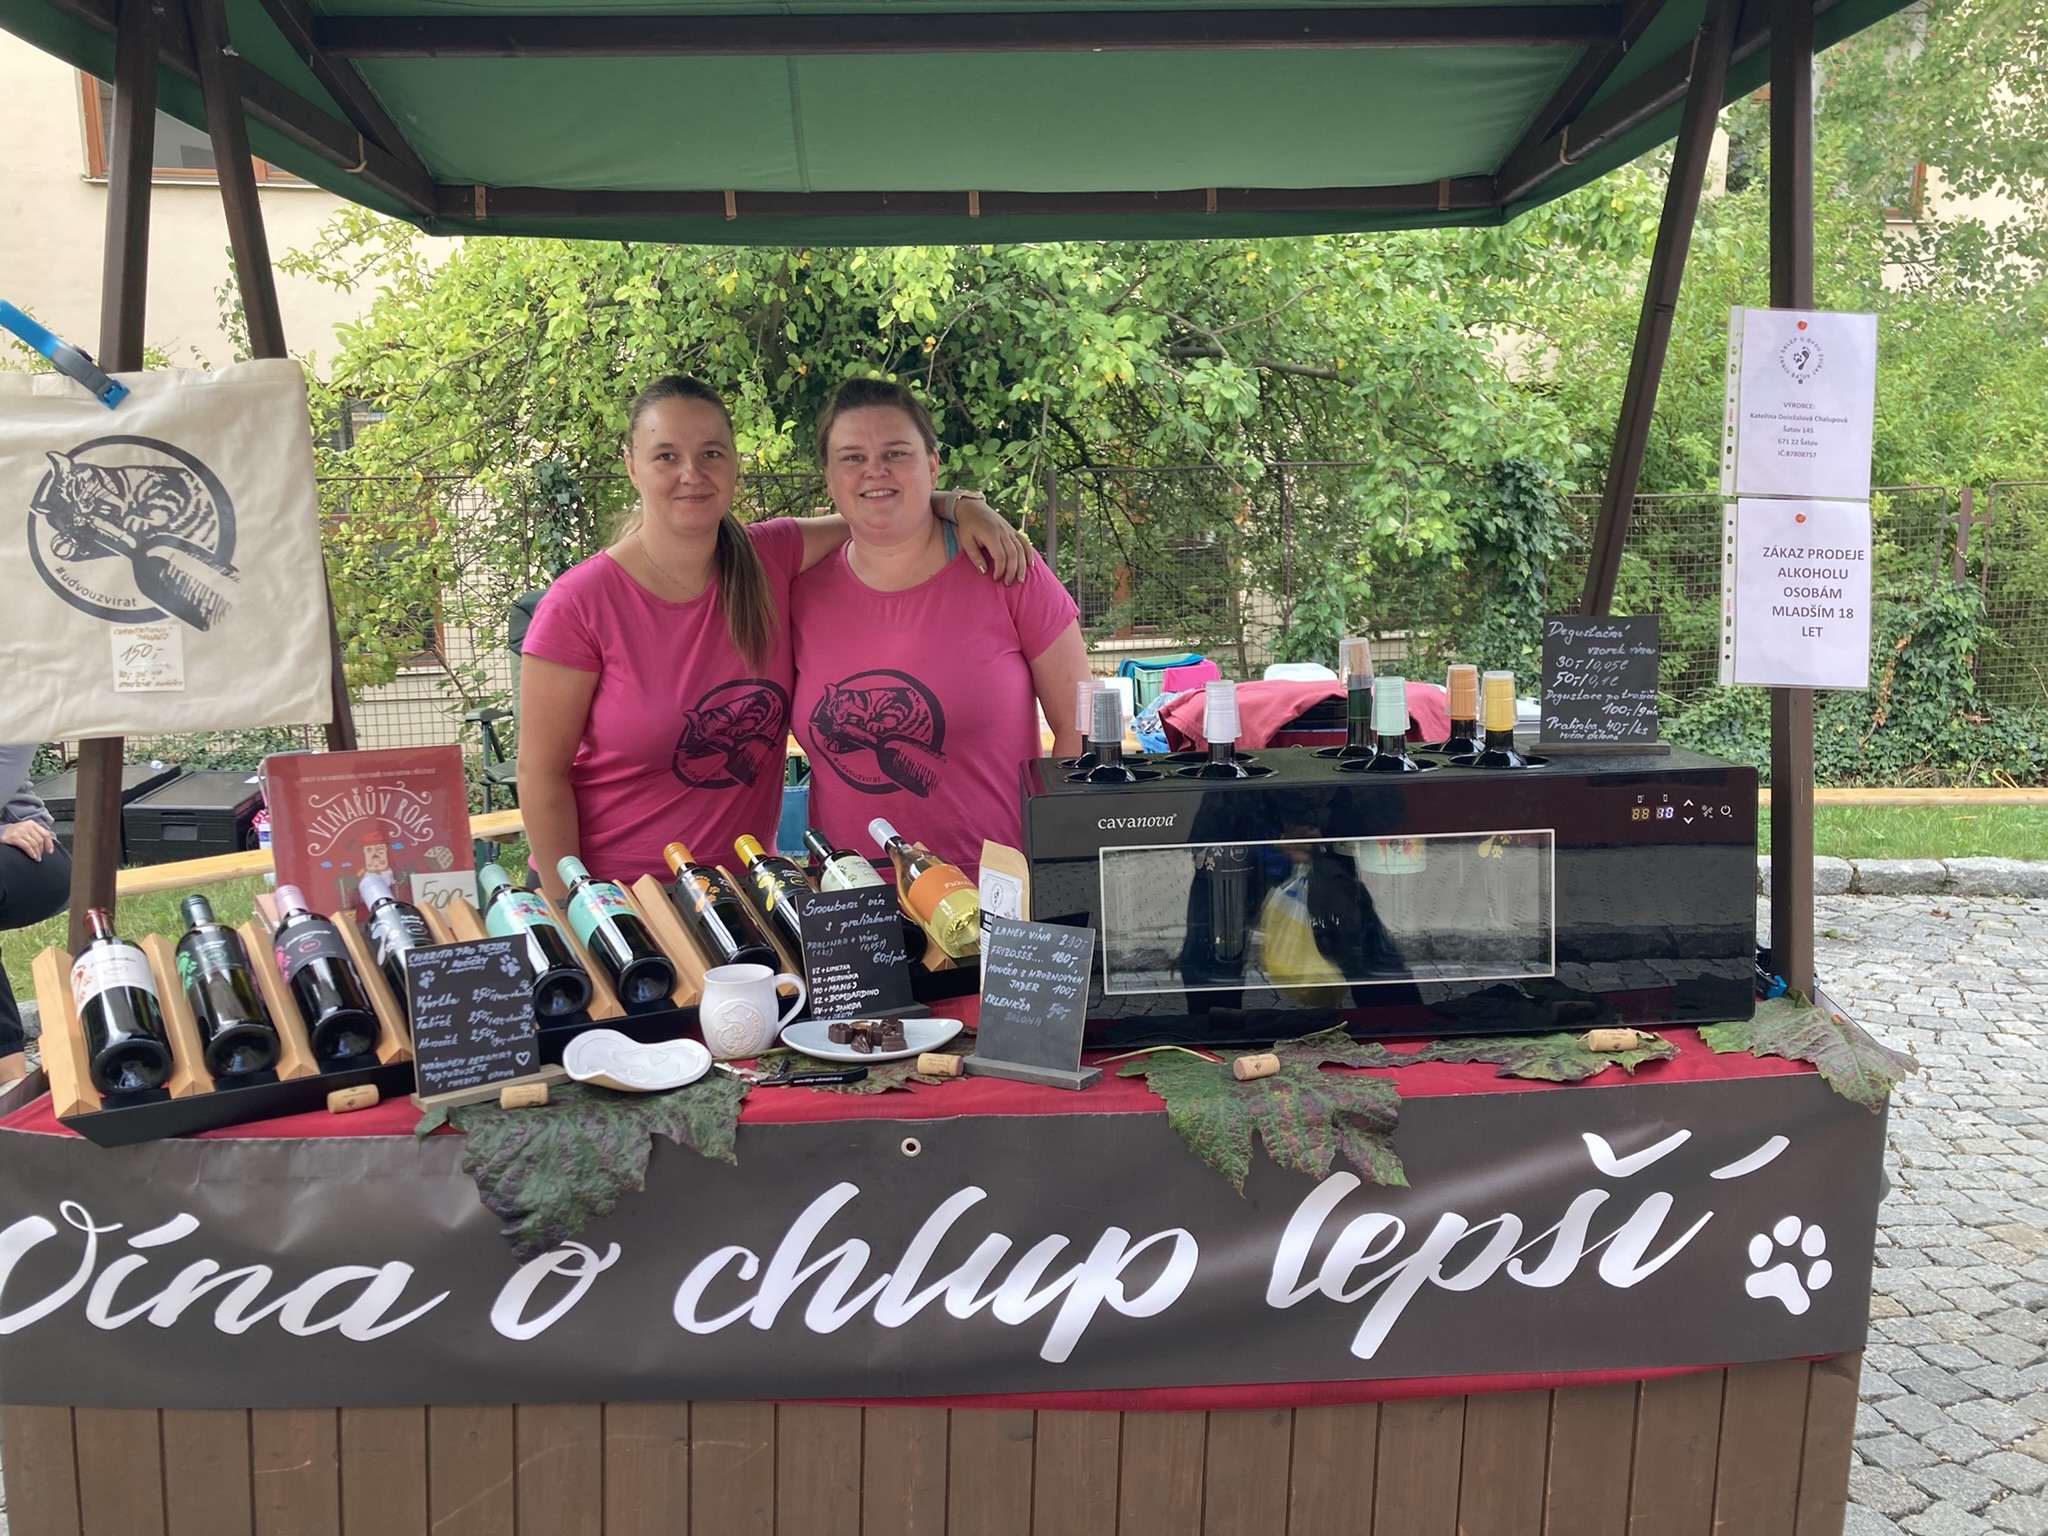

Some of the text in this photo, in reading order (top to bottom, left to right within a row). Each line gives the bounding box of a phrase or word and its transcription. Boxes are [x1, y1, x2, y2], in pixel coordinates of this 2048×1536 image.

[1750, 412, 1848, 424] Kateřina Doležalová Chalupová
[1783, 426, 1801, 434] Šatov
[1800, 438, 1818, 447] Šatov
[1763, 545, 1865, 561] ZÁKAZ PRODEJE
[1777, 567, 1848, 580] ALKOHOLU
[55, 565, 138, 608] #udvouzvirat
[1783, 585, 1842, 599] OSOBÁM
[1772, 604, 1854, 619] MLADŠÍM 18
[1547, 621, 1631, 645] Degustační
[1801, 626, 1823, 637] LET
[1588, 643, 1625, 655] vzorek
[1544, 689, 1603, 706] Degustace
[1605, 694, 1620, 704] po
[1545, 717, 1598, 730] Pralinka
[833, 757, 882, 783] #udvouzvirat
[307, 786, 432, 839] VINAŘŮV ROK
[1098, 814, 1174, 829] cavanova
[802, 893, 886, 917] Snoubení vín
[840, 910, 900, 934] pralinkami
[806, 937, 848, 950] PRALINKA
[859, 929, 880, 943] VÍNO
[994, 926, 1026, 938] LAHEV
[1029, 927, 1052, 942] VÍNA
[408, 948, 454, 963] CHARITA
[1051, 951, 1079, 968] 180,-
[826, 964, 851, 973] LIMETKA
[987, 962, 1018, 976] MOUČKA
[1028, 969, 1085, 984] HROZNOVÝCH
[812, 987, 823, 995] MO
[828, 981, 858, 993] MANGO
[828, 988, 880, 1003] BOMBARDINO
[1009, 979, 1077, 999] JADER 100,-
[416, 992, 460, 1015] Vývrtka
[834, 1001, 862, 1013] JAHODA
[984, 993, 1031, 1012] SKLENIČKA
[0, 1130, 1790, 1363] Vína o chlup lepší
